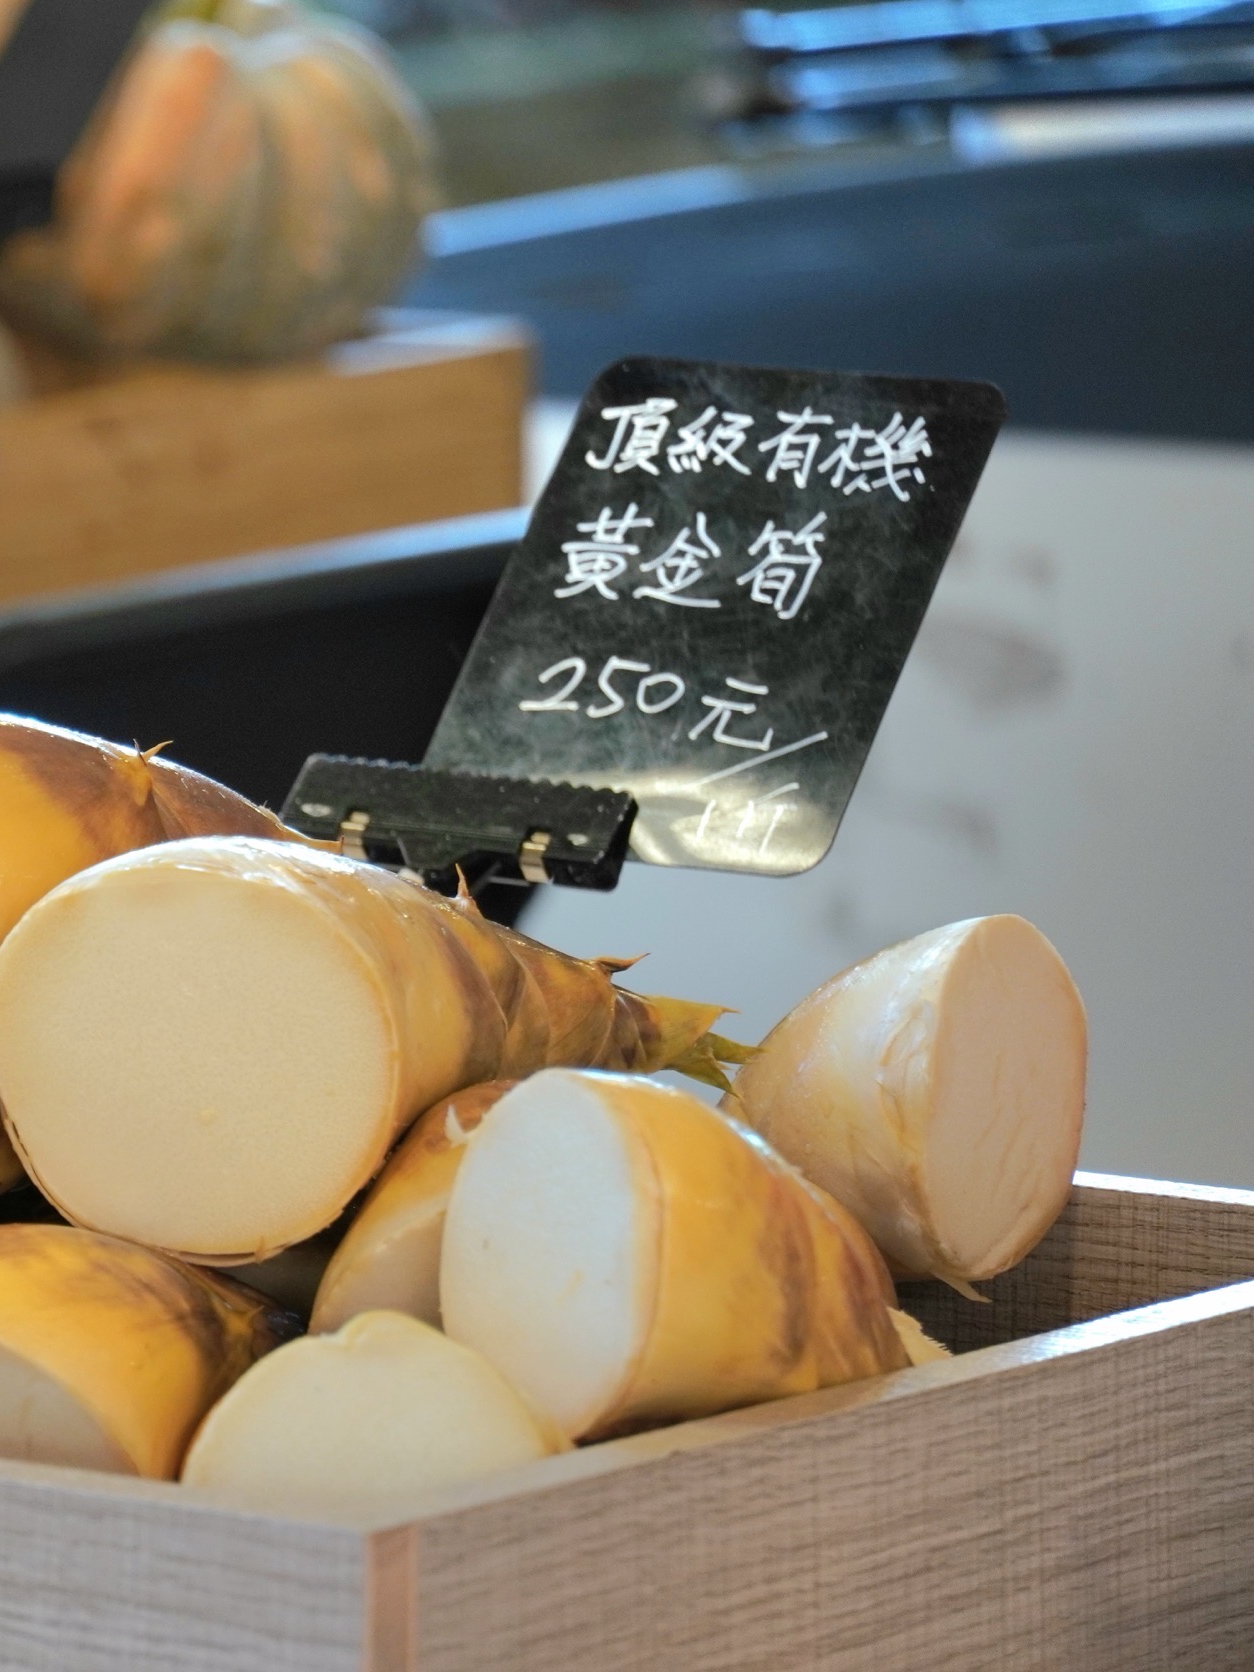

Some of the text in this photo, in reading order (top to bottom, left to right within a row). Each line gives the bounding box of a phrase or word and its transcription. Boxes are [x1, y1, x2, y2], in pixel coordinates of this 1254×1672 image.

[585, 397, 933, 503] 頂級有機
[553, 502, 827, 619] 黃金筍
